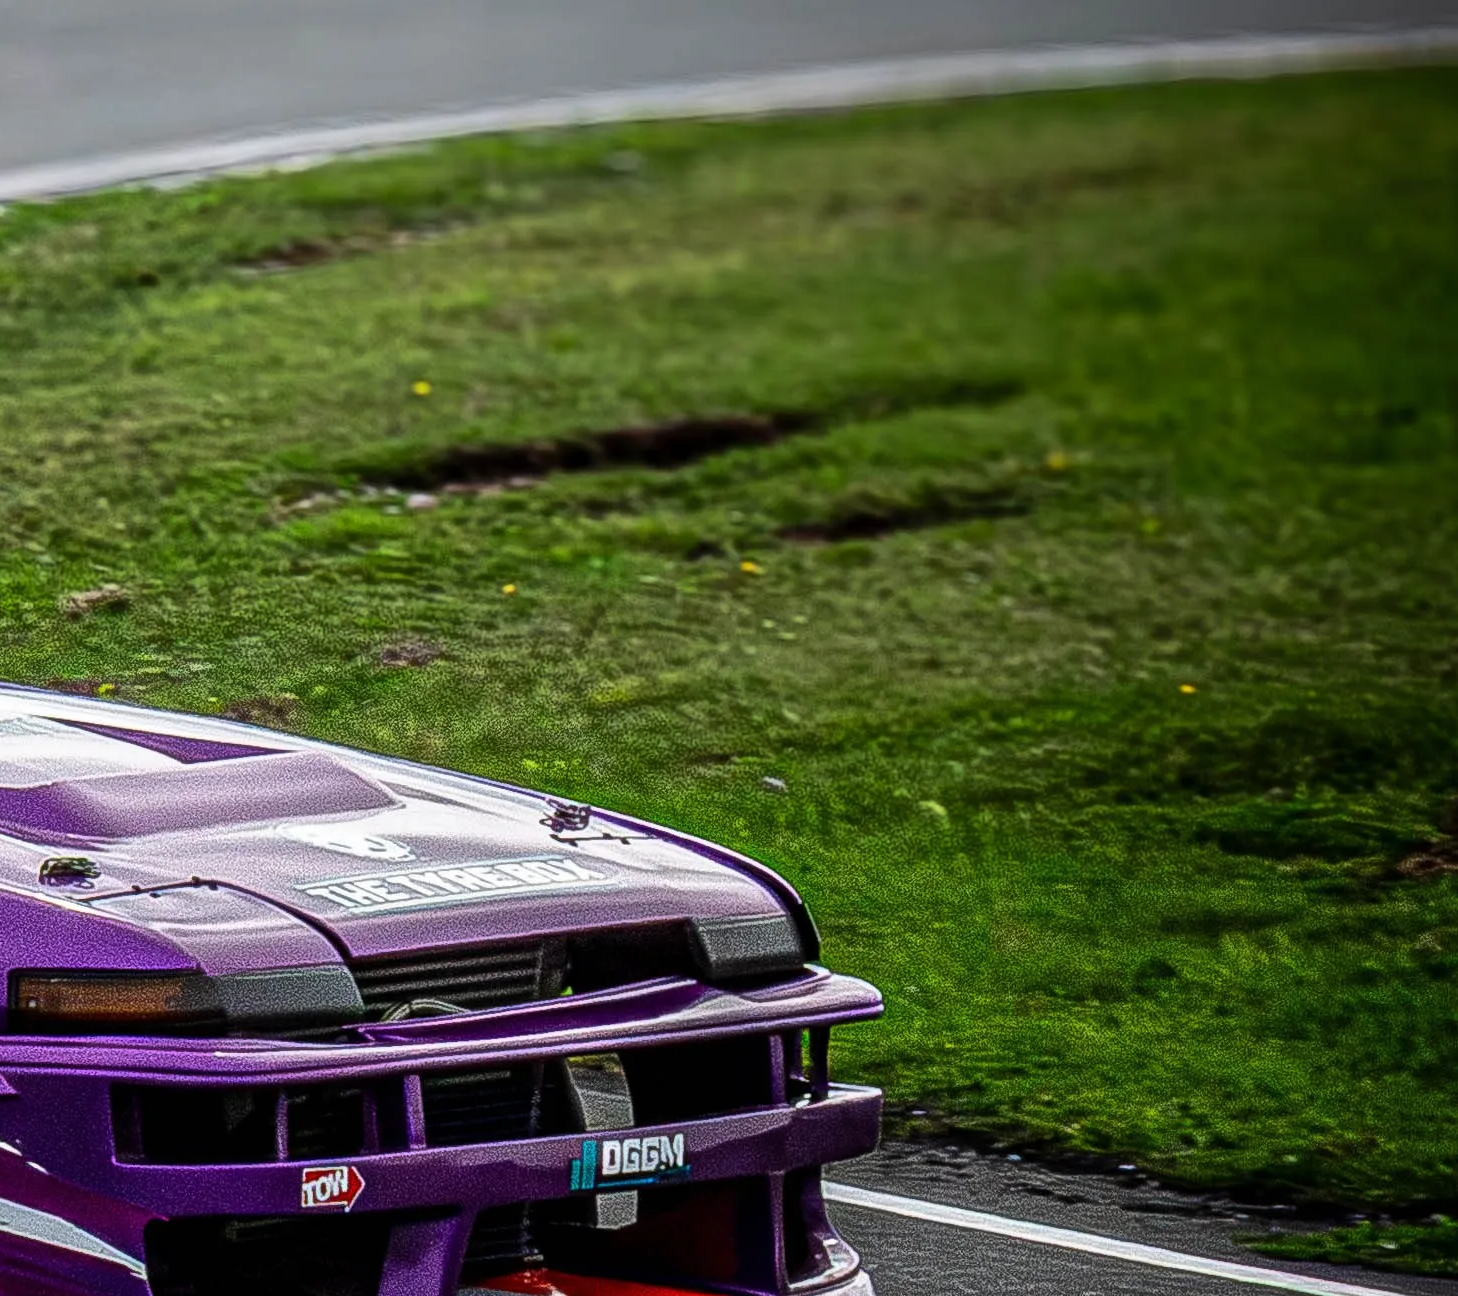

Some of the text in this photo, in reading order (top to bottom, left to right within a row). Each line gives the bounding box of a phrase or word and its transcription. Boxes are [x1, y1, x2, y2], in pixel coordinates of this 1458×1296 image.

[305, 859, 608, 908] THE TYRE BOX
[601, 1133, 684, 1176] DGGM
[303, 1167, 348, 1207] TOW
